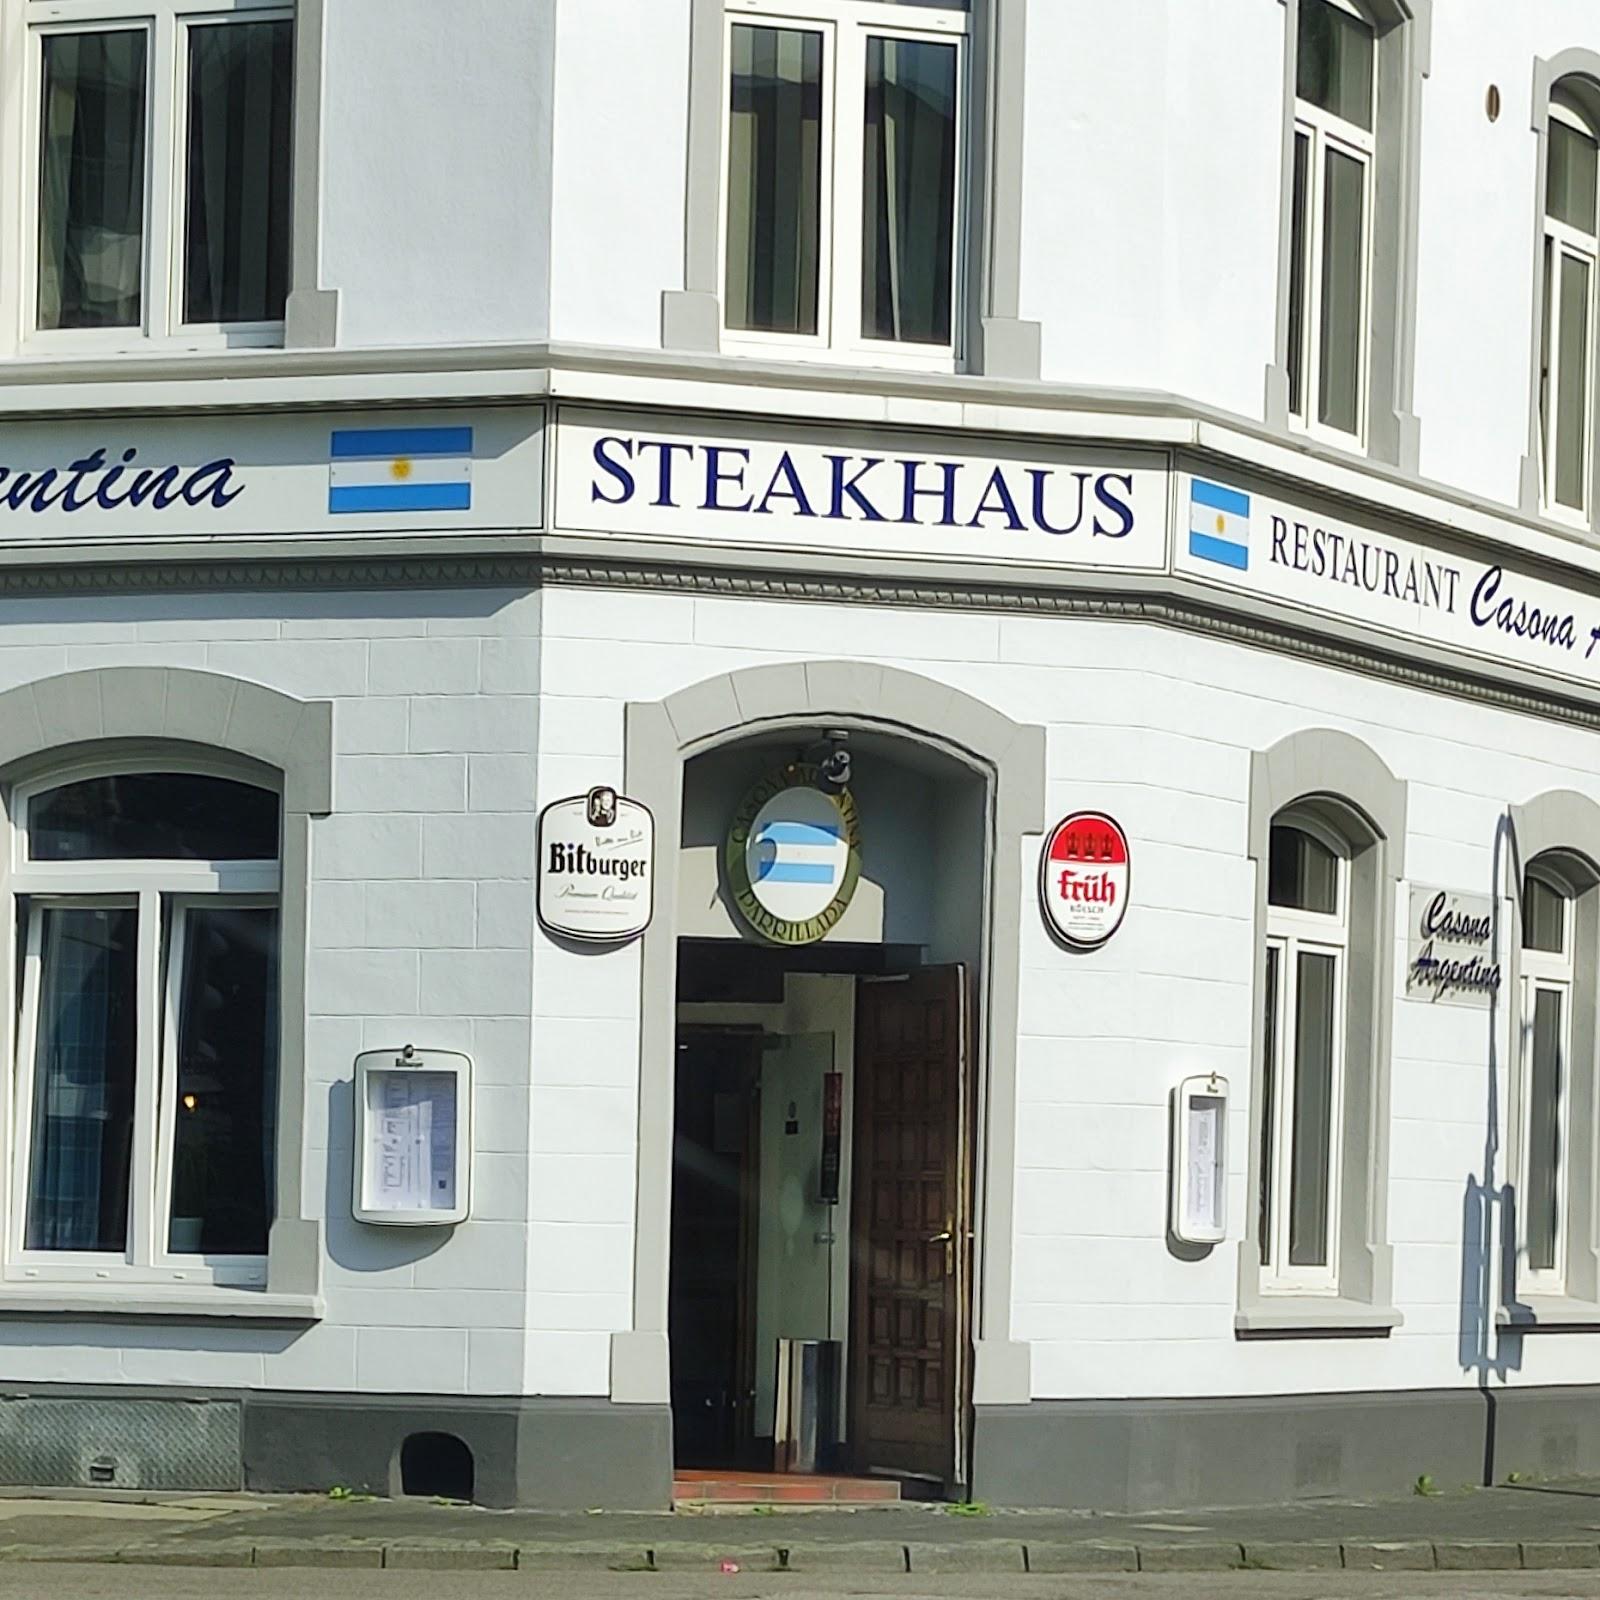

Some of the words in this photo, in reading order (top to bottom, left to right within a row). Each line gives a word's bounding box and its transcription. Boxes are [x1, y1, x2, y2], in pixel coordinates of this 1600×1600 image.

[591, 436, 1135, 539] STEAKHAUS
[1270, 515, 1460, 613] RESTAURANT
[1470, 565, 1577, 650] Casona
[547, 842, 647, 881] Bitburger
[738, 890, 849, 942] PARRILLADA
[1426, 891, 1491, 940] Casona
[1409, 940, 1501, 1003] Argentina
